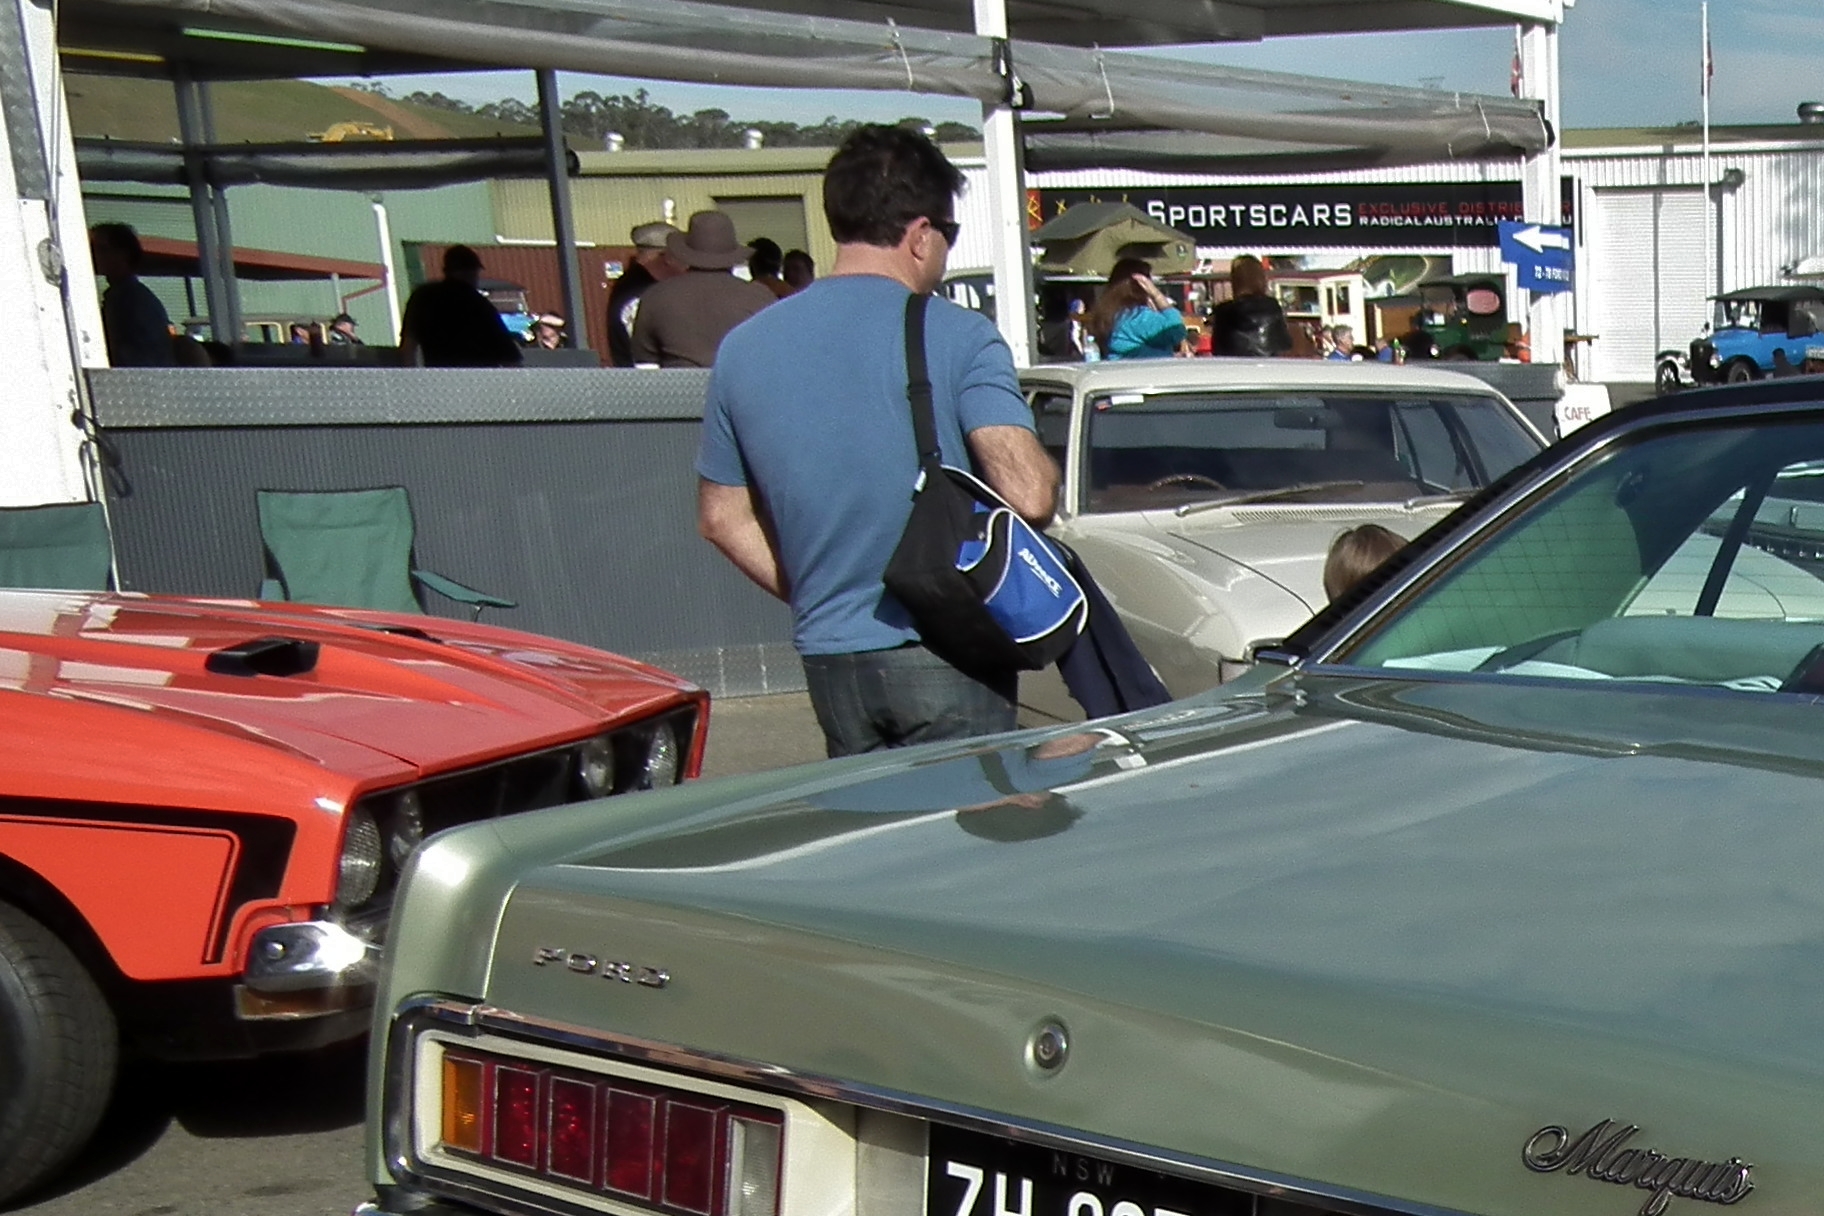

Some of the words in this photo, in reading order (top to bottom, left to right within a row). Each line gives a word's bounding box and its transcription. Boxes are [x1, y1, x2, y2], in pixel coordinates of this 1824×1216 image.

[1147, 200, 1352, 228] SPORTSCARS
[1358, 202, 1448, 215] EXCLUSIVE
[1564, 406, 1592, 421] CAFE
[533, 947, 671, 989] FORD
[1051, 1152, 1115, 1187] NSW
